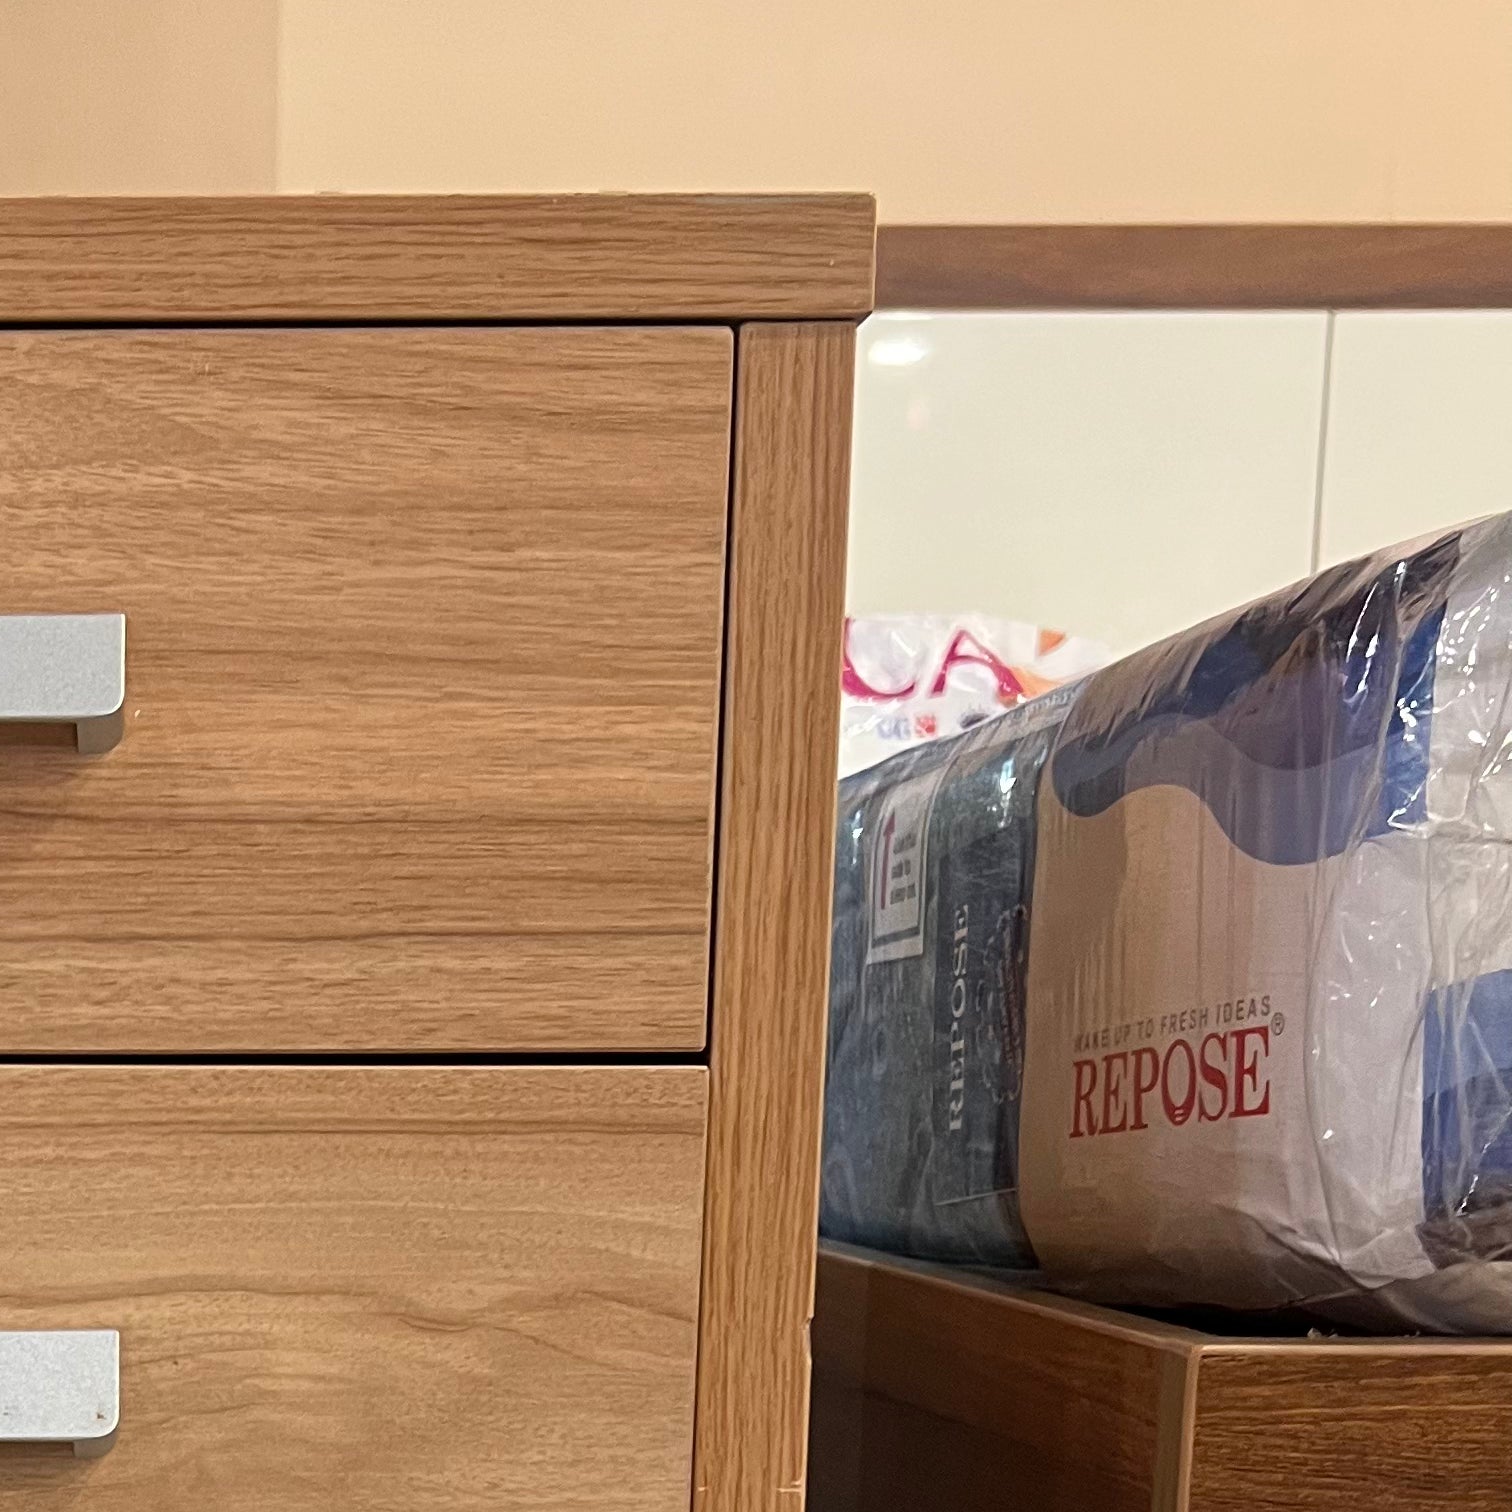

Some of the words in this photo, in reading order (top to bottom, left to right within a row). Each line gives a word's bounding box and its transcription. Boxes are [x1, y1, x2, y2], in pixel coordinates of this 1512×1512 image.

[948, 903, 969, 1132] REPOSE
[1114, 1024, 1131, 1047] UP
[1137, 1018, 1155, 1040] TO
[1160, 1007, 1208, 1035] FRESH
[1215, 995, 1271, 1023] IDEAS
[1069, 1026, 1270, 1138] REPOSE
